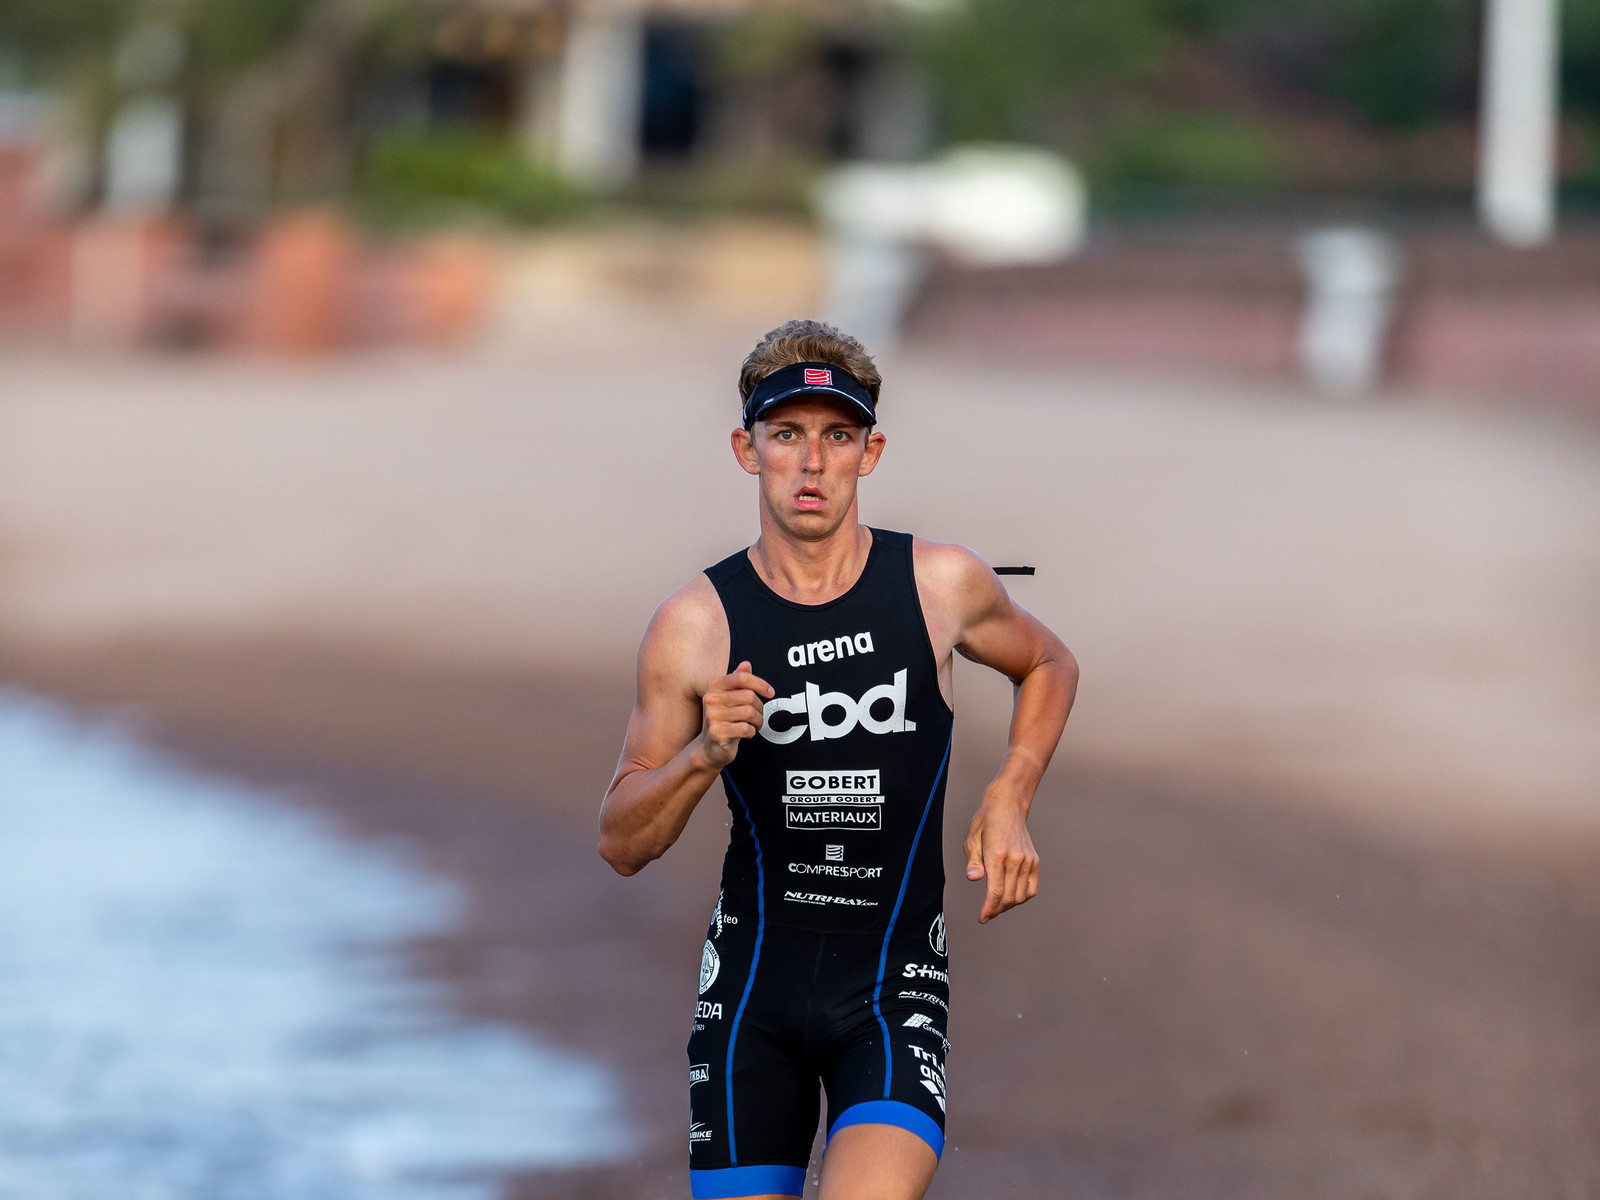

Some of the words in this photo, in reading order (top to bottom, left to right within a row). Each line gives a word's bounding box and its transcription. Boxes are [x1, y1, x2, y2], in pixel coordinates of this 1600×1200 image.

[787, 631, 875, 668] arena
[789, 775, 877, 790] GOBERT
[789, 811, 878, 824] MATERIAUX
[788, 862, 884, 879] COMPRESSPORT
[902, 963, 949, 986] Stimi
